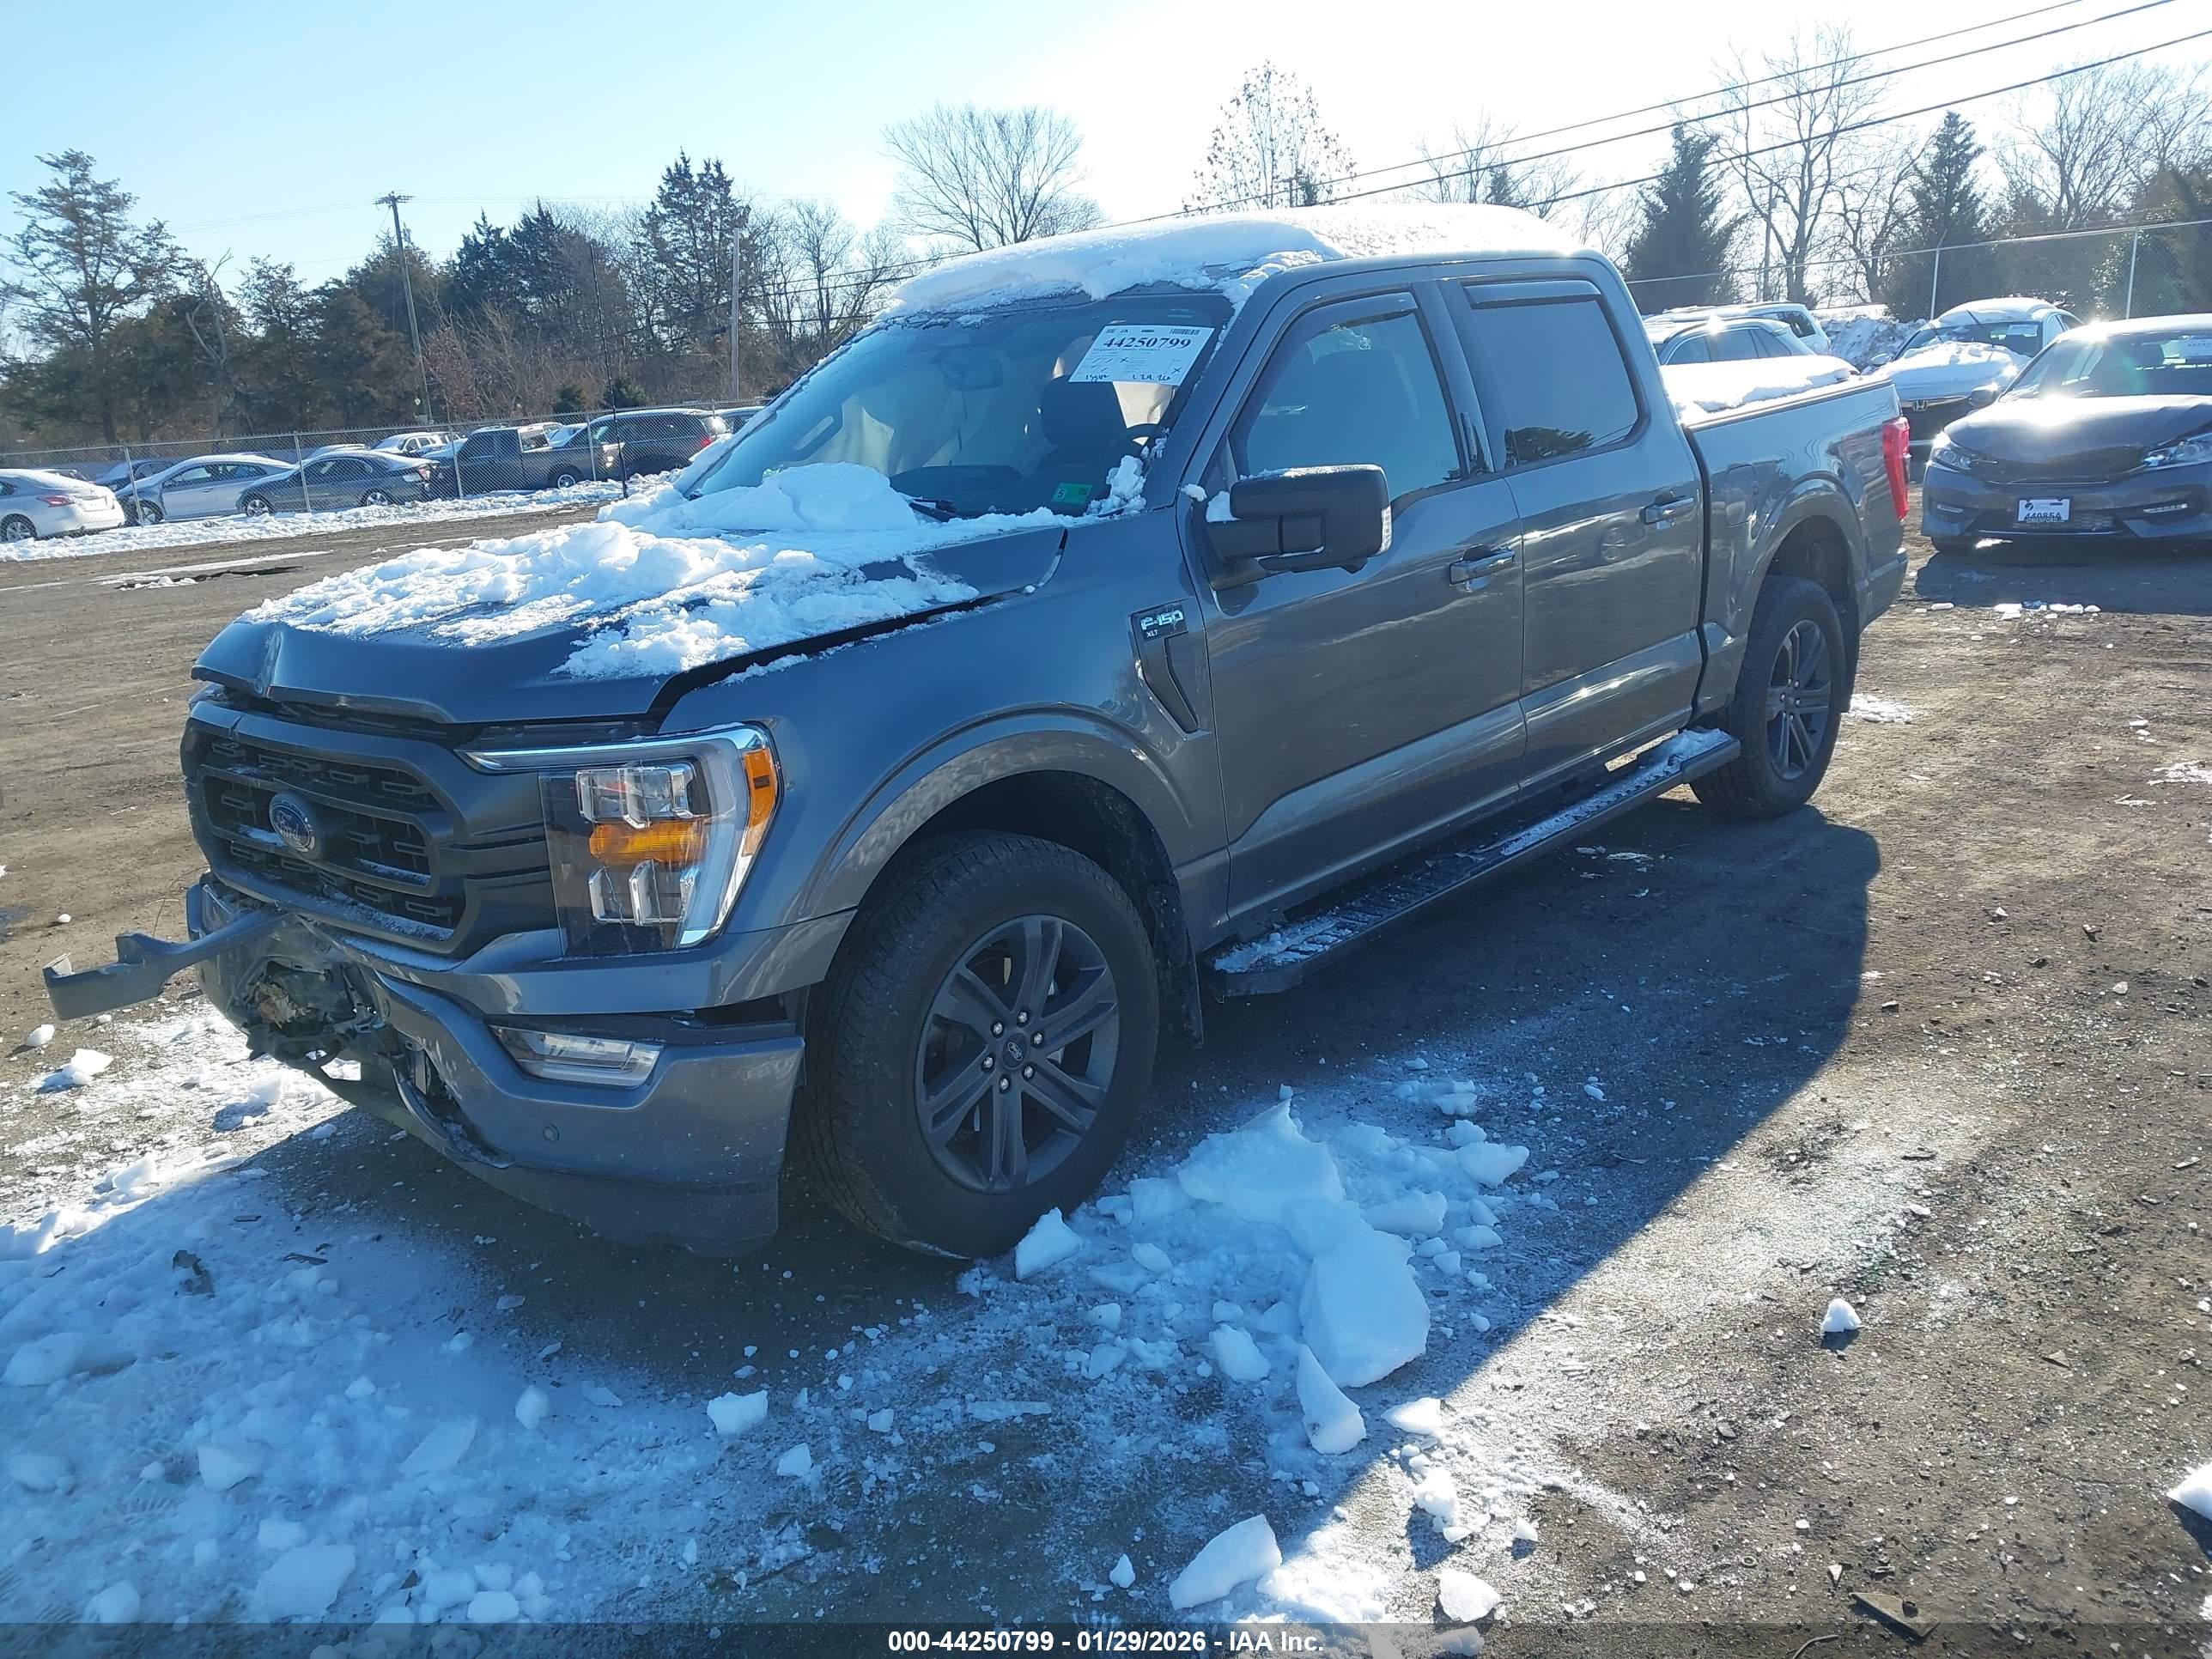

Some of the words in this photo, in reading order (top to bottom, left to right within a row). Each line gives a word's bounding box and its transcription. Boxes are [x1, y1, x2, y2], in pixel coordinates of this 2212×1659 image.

[1103, 337, 1192, 349] 44250799
[1140, 609, 1184, 631] F-150
[1146, 629, 1159, 638] XLT
